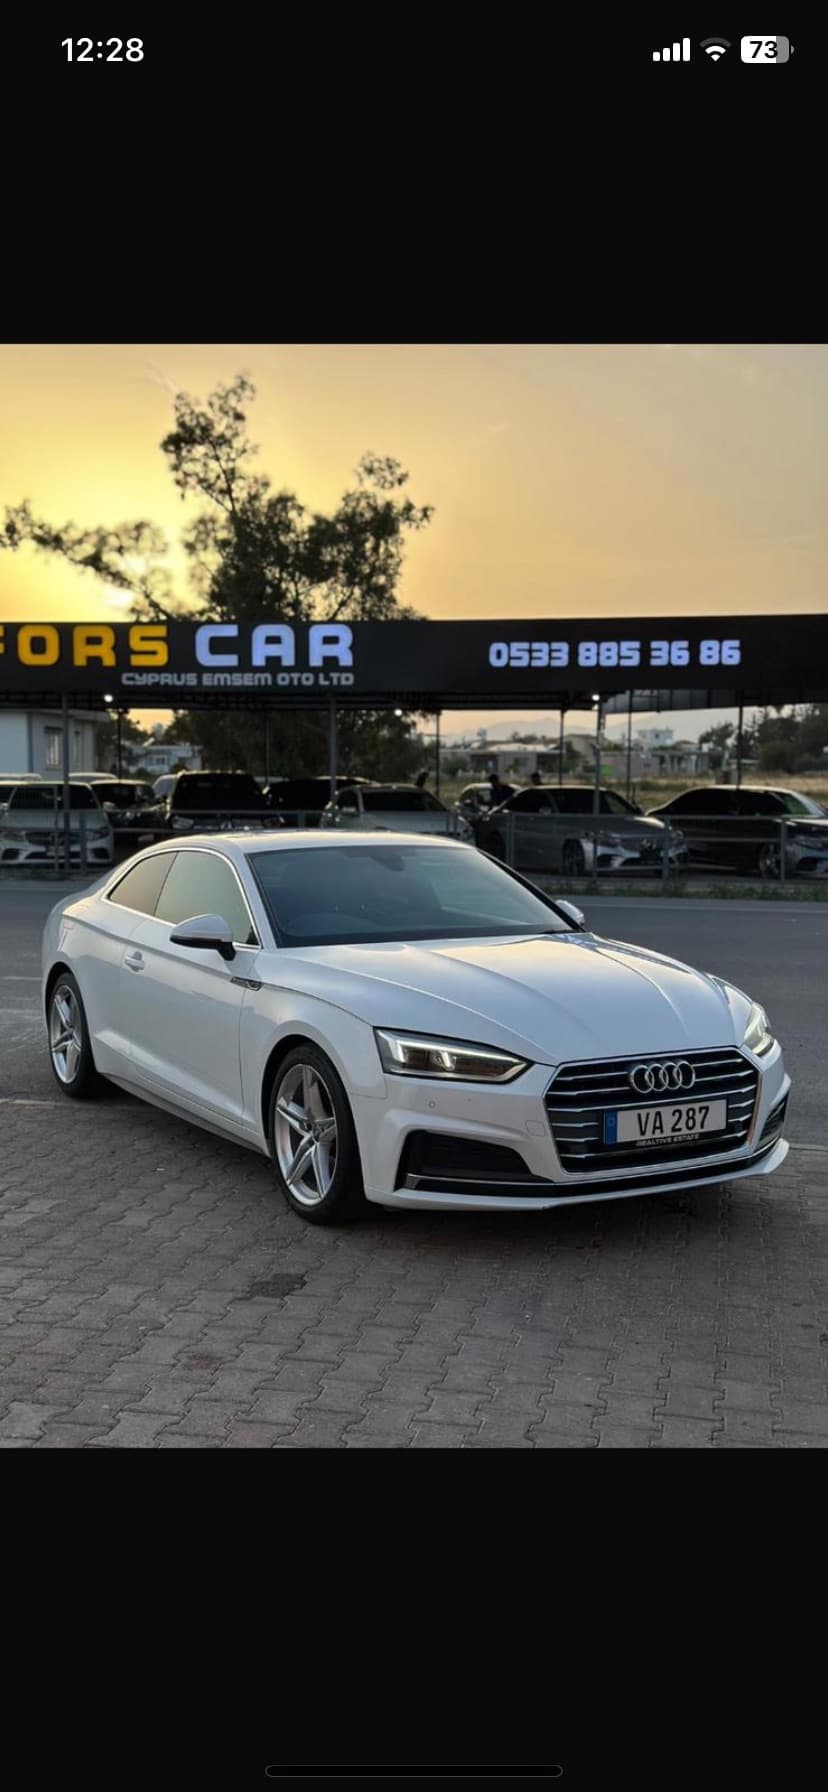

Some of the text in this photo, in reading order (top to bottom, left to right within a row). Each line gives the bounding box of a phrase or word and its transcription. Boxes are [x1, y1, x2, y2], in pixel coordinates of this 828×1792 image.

[0, 624, 354, 667] ORS CAR
[488, 639, 741, 668] 0533 885 36 86
[121, 672, 355, 687] CYPRUS EMSEM OTO LTD
[637, 1105, 710, 1136] VA 287
[673, 1133, 699, 1142] ESTATE
